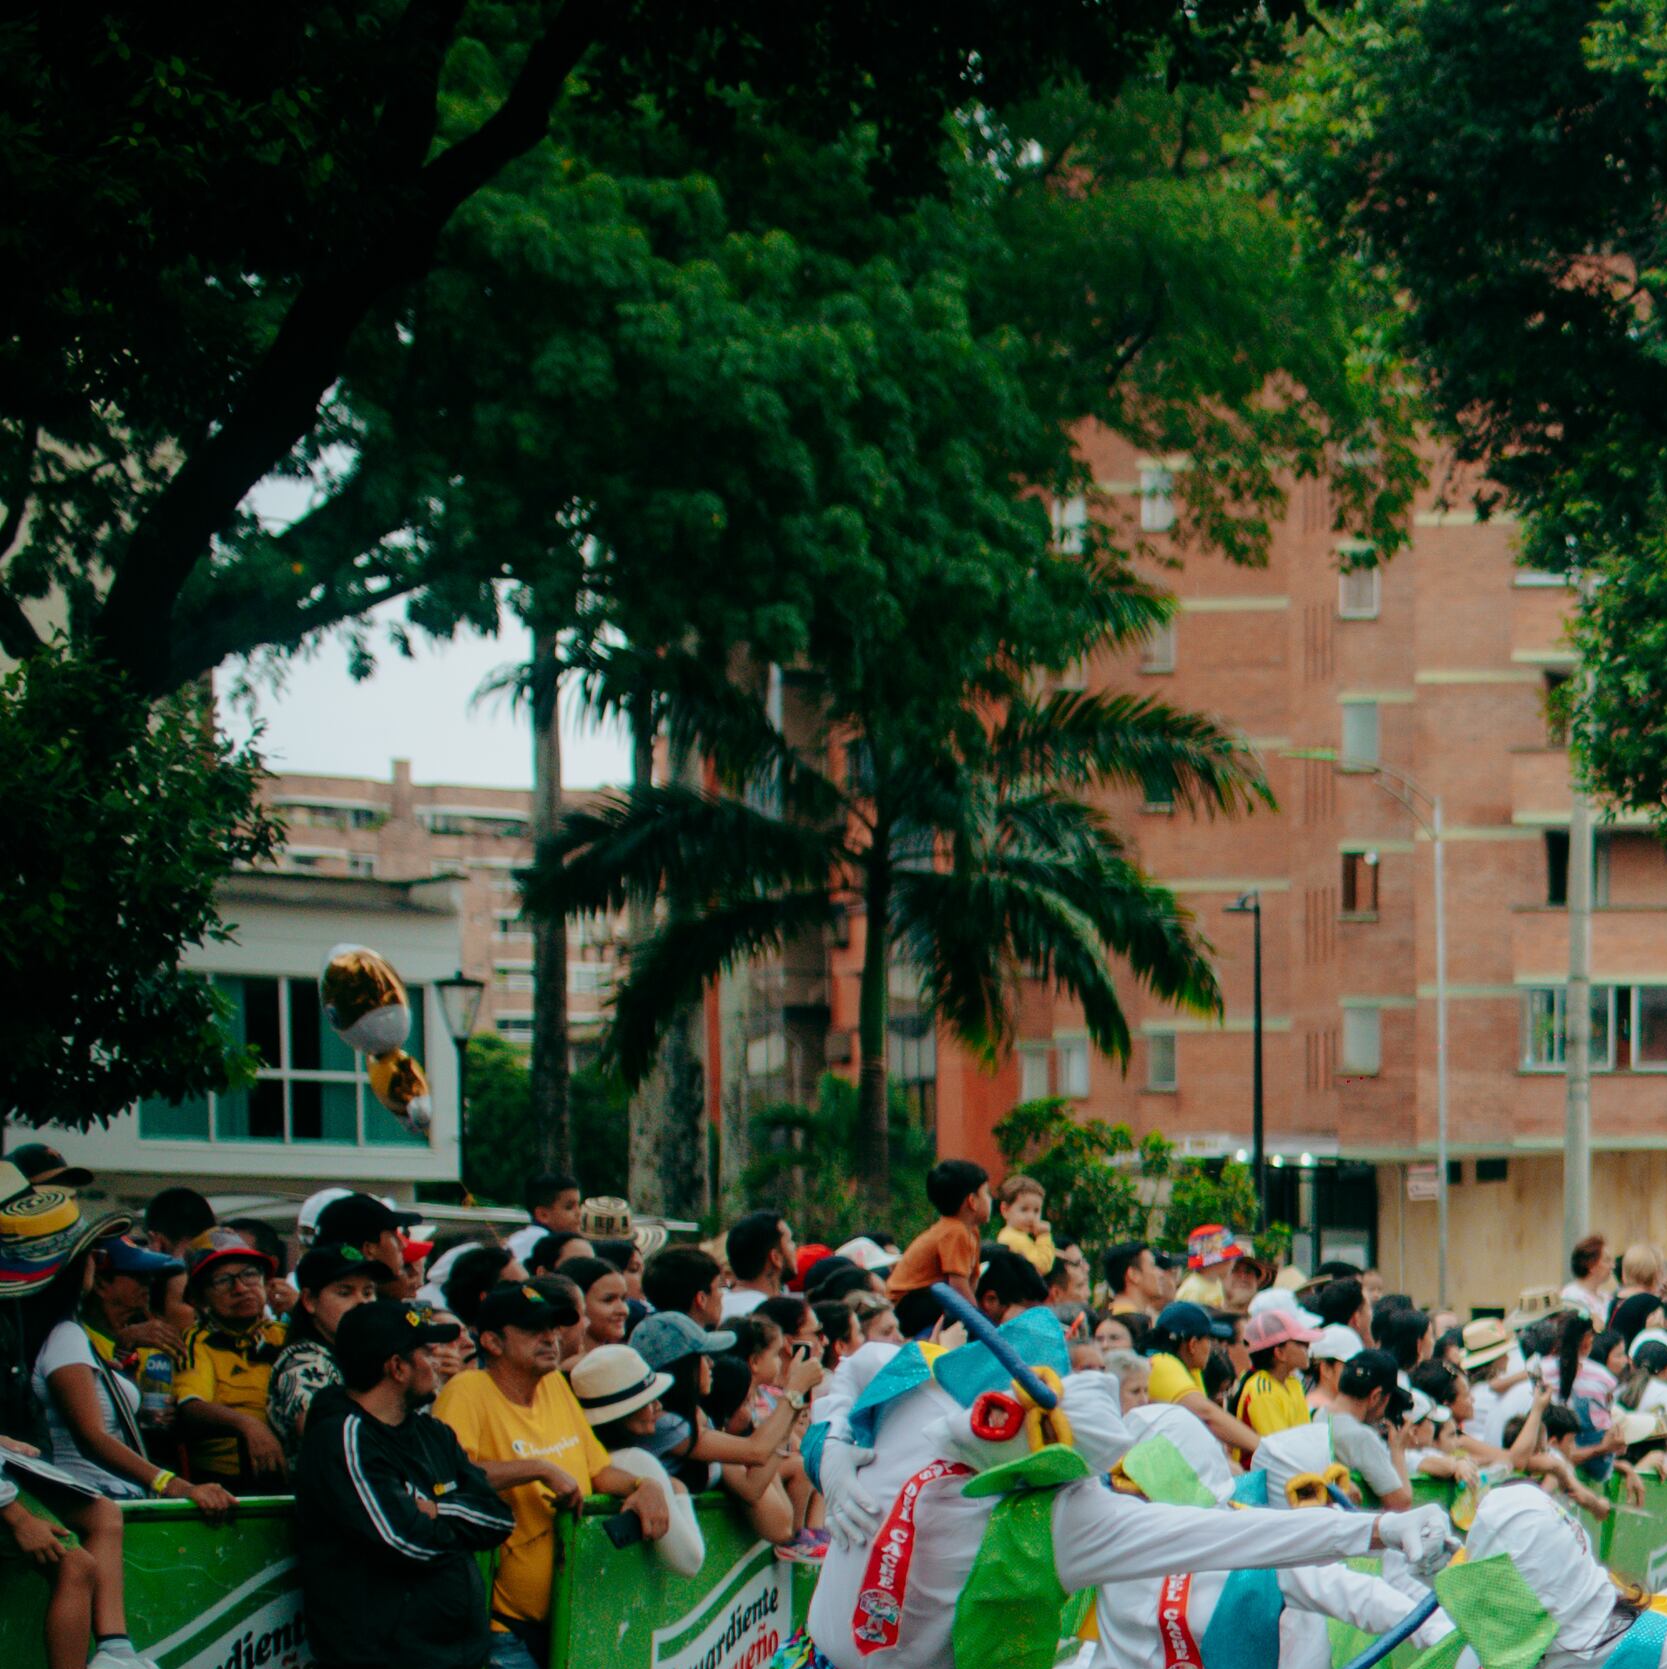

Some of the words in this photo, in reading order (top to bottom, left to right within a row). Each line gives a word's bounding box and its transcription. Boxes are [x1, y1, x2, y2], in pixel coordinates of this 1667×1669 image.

[511, 1435, 581, 1458] Champion
[901, 1482, 917, 1522] DEL
[1163, 1608, 1190, 1661] CACHE
